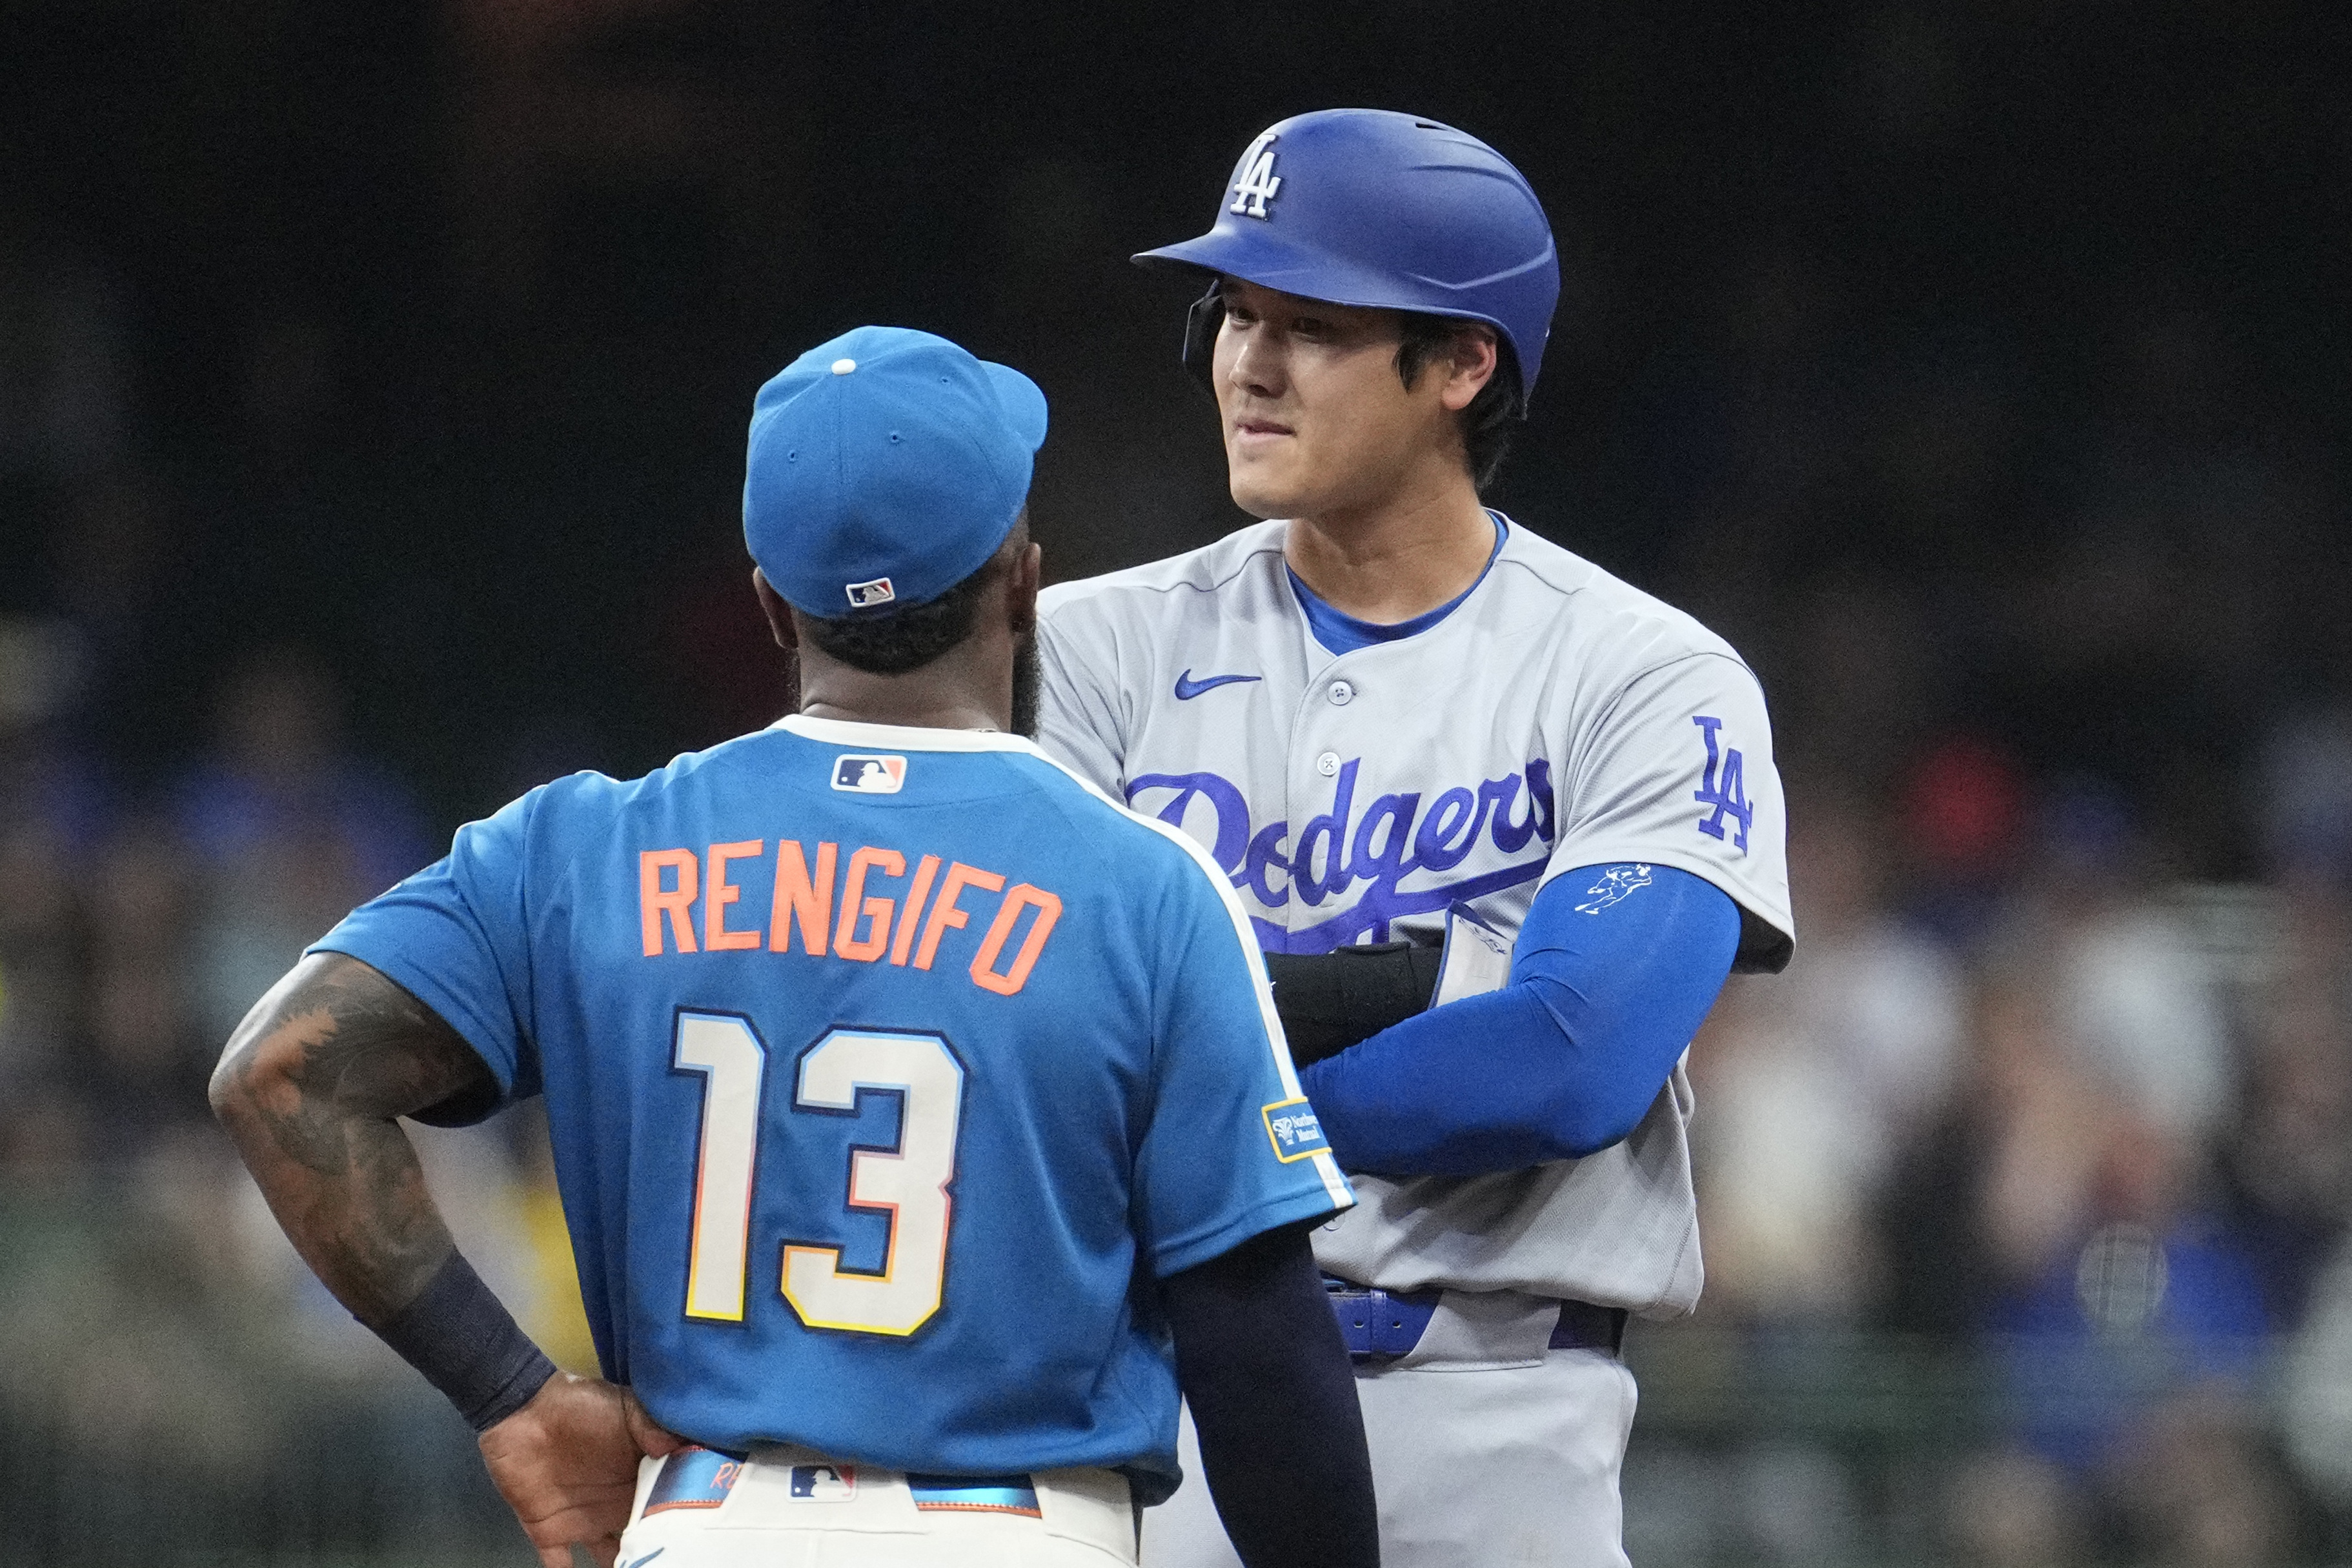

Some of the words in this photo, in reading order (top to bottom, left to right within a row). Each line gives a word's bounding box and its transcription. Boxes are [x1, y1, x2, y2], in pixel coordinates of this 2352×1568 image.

[1230, 134, 1281, 217] LA
[1126, 757, 1555, 954] Dodgers
[1692, 716, 1753, 858] LA
[640, 839, 1062, 996] RENGIFO
[674, 1006, 968, 1338] 13
